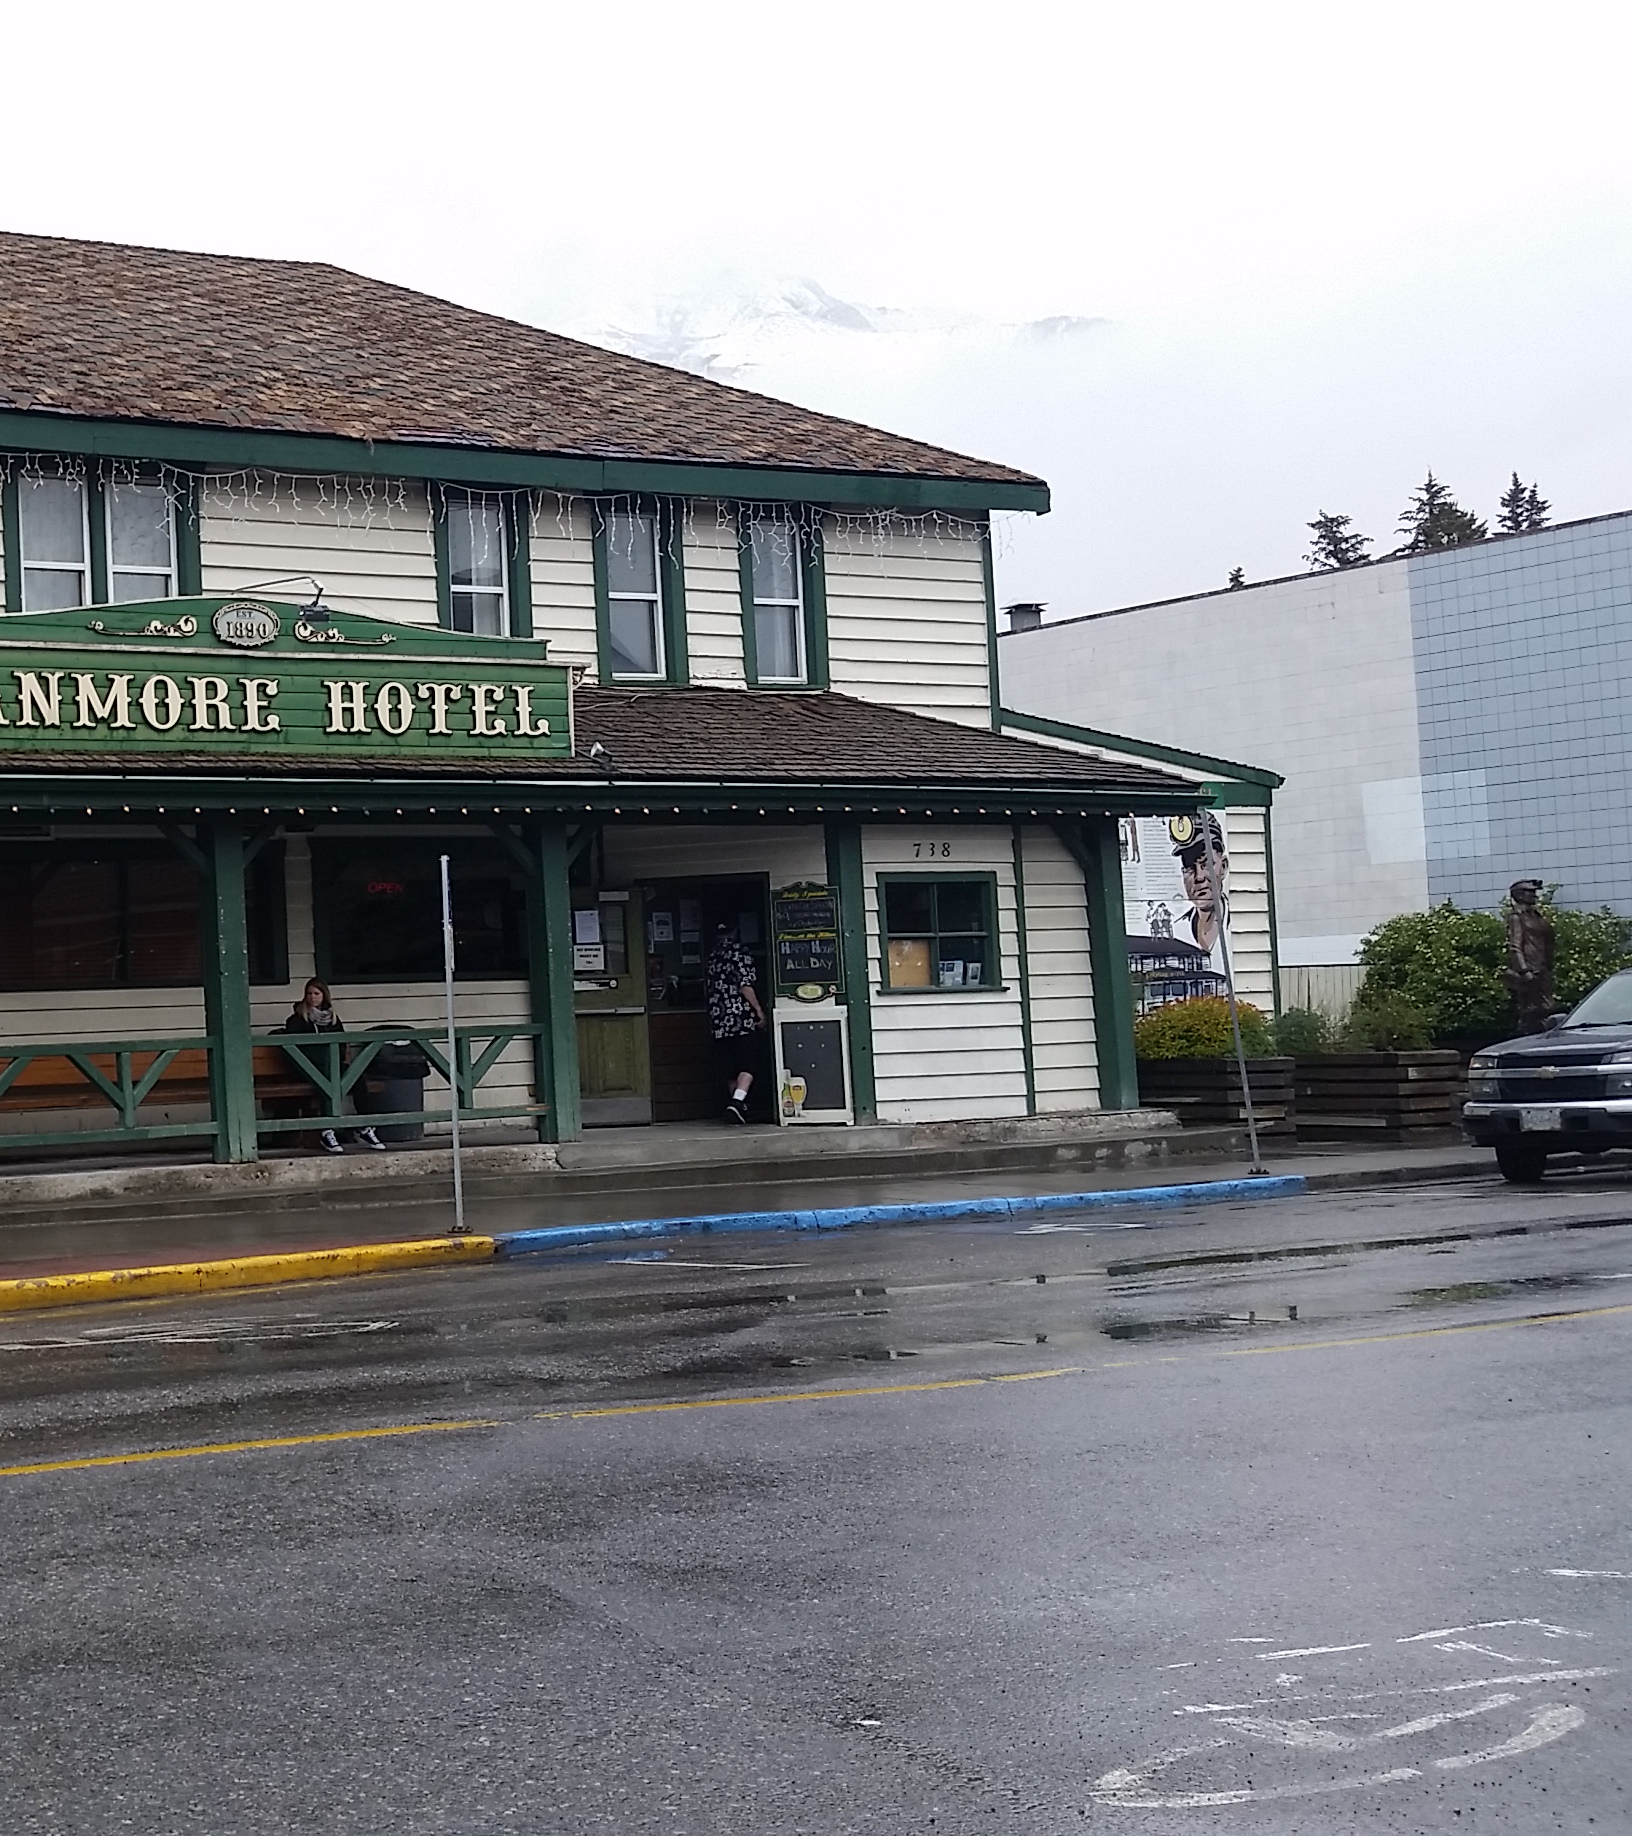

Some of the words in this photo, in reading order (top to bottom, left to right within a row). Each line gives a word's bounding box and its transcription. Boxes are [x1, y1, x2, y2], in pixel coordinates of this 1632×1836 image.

[226, 621, 269, 639] 1890
[323, 679, 552, 739] HOTEL
[912, 842, 951, 858] 738
[367, 881, 405, 894] OPEN
[786, 959, 810, 970] ALL
[810, 957, 833, 970] DAY
